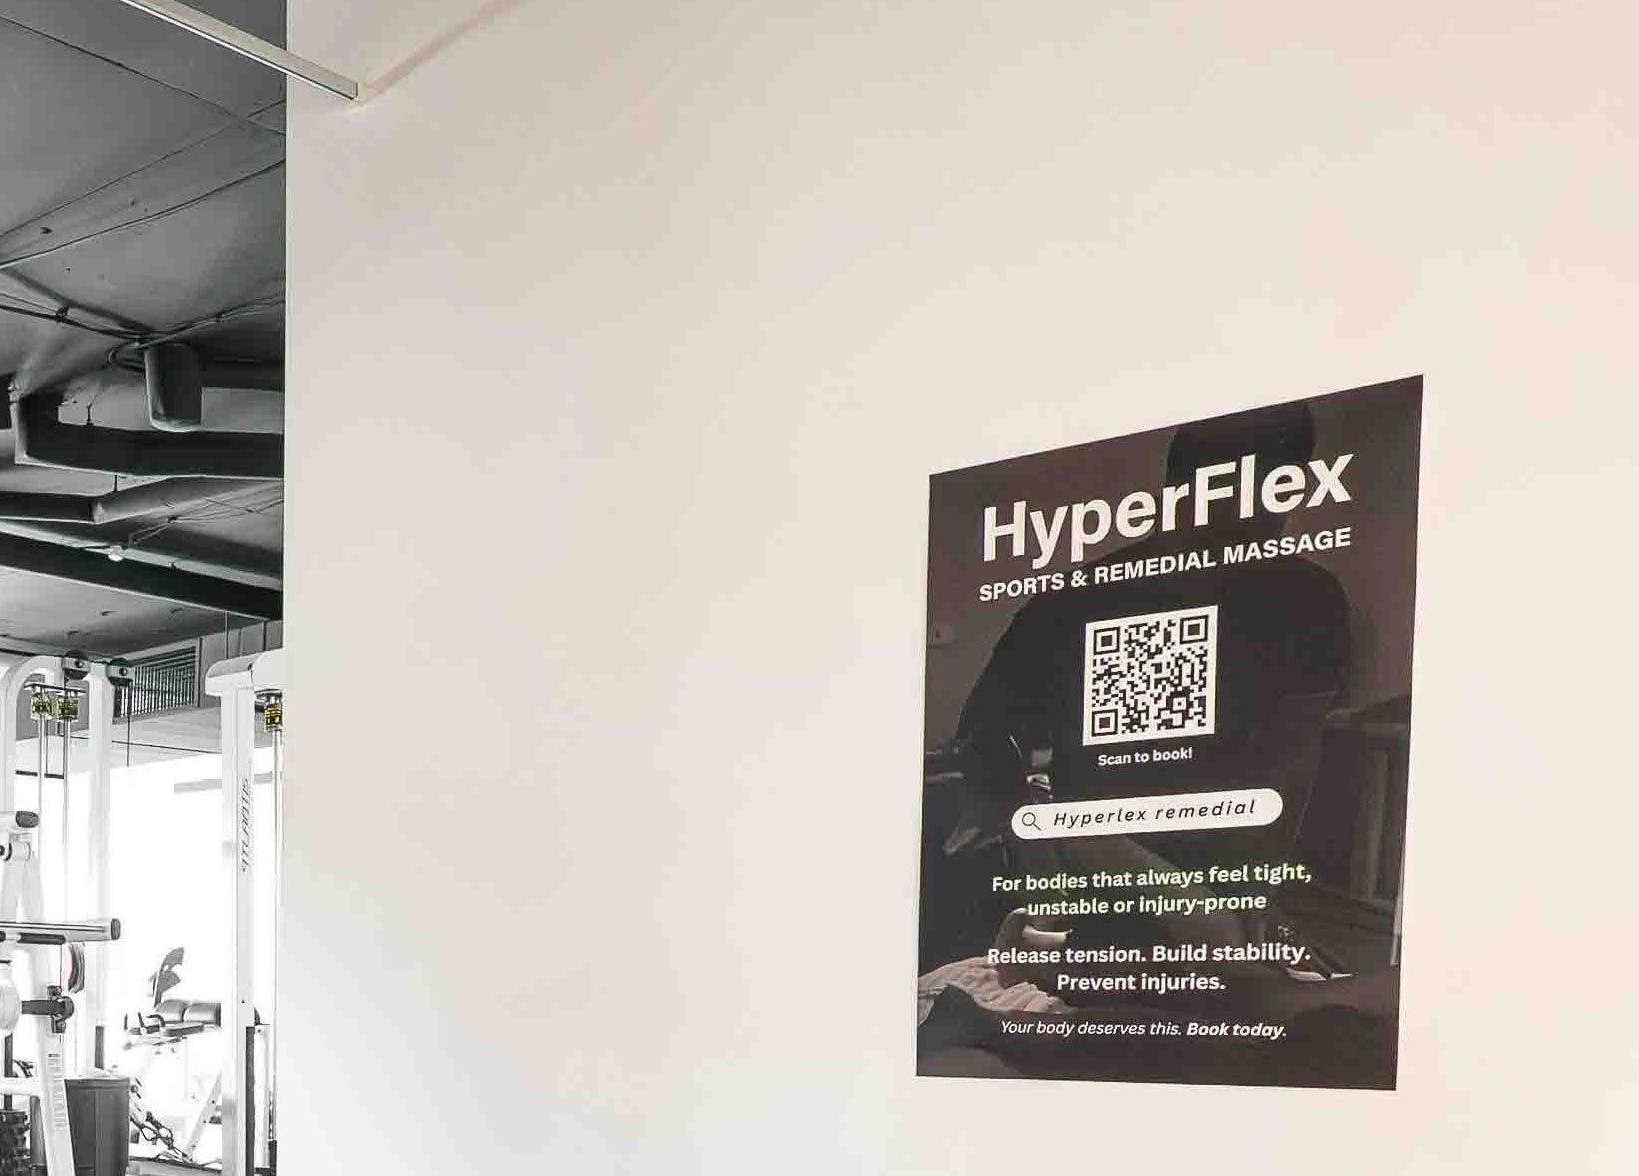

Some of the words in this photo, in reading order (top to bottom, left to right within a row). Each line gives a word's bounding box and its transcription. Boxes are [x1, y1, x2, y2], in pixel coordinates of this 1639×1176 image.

[983, 453, 1354, 570] HyperFlex
[979, 572, 1065, 602] SPORTS
[1070, 569, 1088, 588] &
[1094, 550, 1217, 585] REMEDIAL
[1223, 526, 1351, 565] MASSAGE
[1097, 753, 1131, 767] Scan
[1134, 751, 1150, 764] to
[1153, 746, 1194, 763] book!
[1155, 799, 1255, 820] remedial
[991, 875, 1022, 892] For
[1025, 872, 1088, 891] bodies
[1092, 870, 1133, 888] that
[1136, 868, 1204, 889] always
[1208, 864, 1249, 884] feel
[1253, 862, 1313, 886] tight,
[1027, 897, 1110, 917] unstable
[1113, 900, 1135, 914] or
[1139, 894, 1267, 917] injury-prone
[987, 947, 1061, 966] Release
[1064, 945, 1147, 964] tension.
[1152, 942, 1208, 963] Build
[1212, 941, 1312, 965] stability.
[1057, 972, 1137, 992] Prevent
[1141, 971, 1227, 995] injuries.
[1000, 1020, 1035, 1036] Your
[1036, 1020, 1074, 1038] body
[1077, 1021, 1146, 1036] deserves
[1149, 1021, 1183, 1037] this.
[1186, 1021, 1230, 1037] Book
[1232, 1021, 1288, 1041] today.
